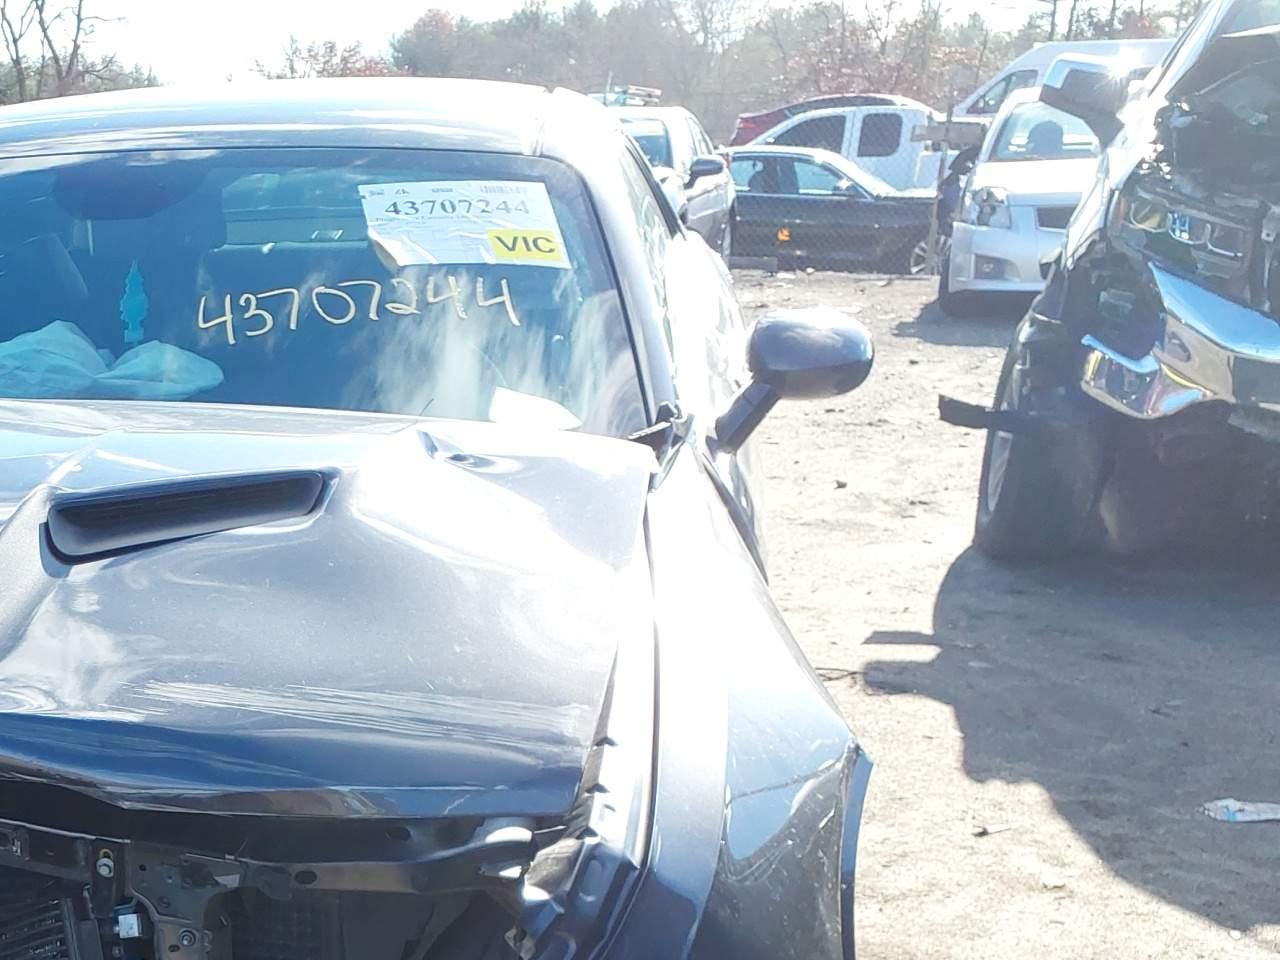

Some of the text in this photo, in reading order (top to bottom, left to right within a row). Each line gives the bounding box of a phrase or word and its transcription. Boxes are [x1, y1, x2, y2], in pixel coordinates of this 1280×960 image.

[385, 200, 530, 216] 43707244
[495, 235, 556, 254] VIC
[198, 276, 520, 344] 43707244
